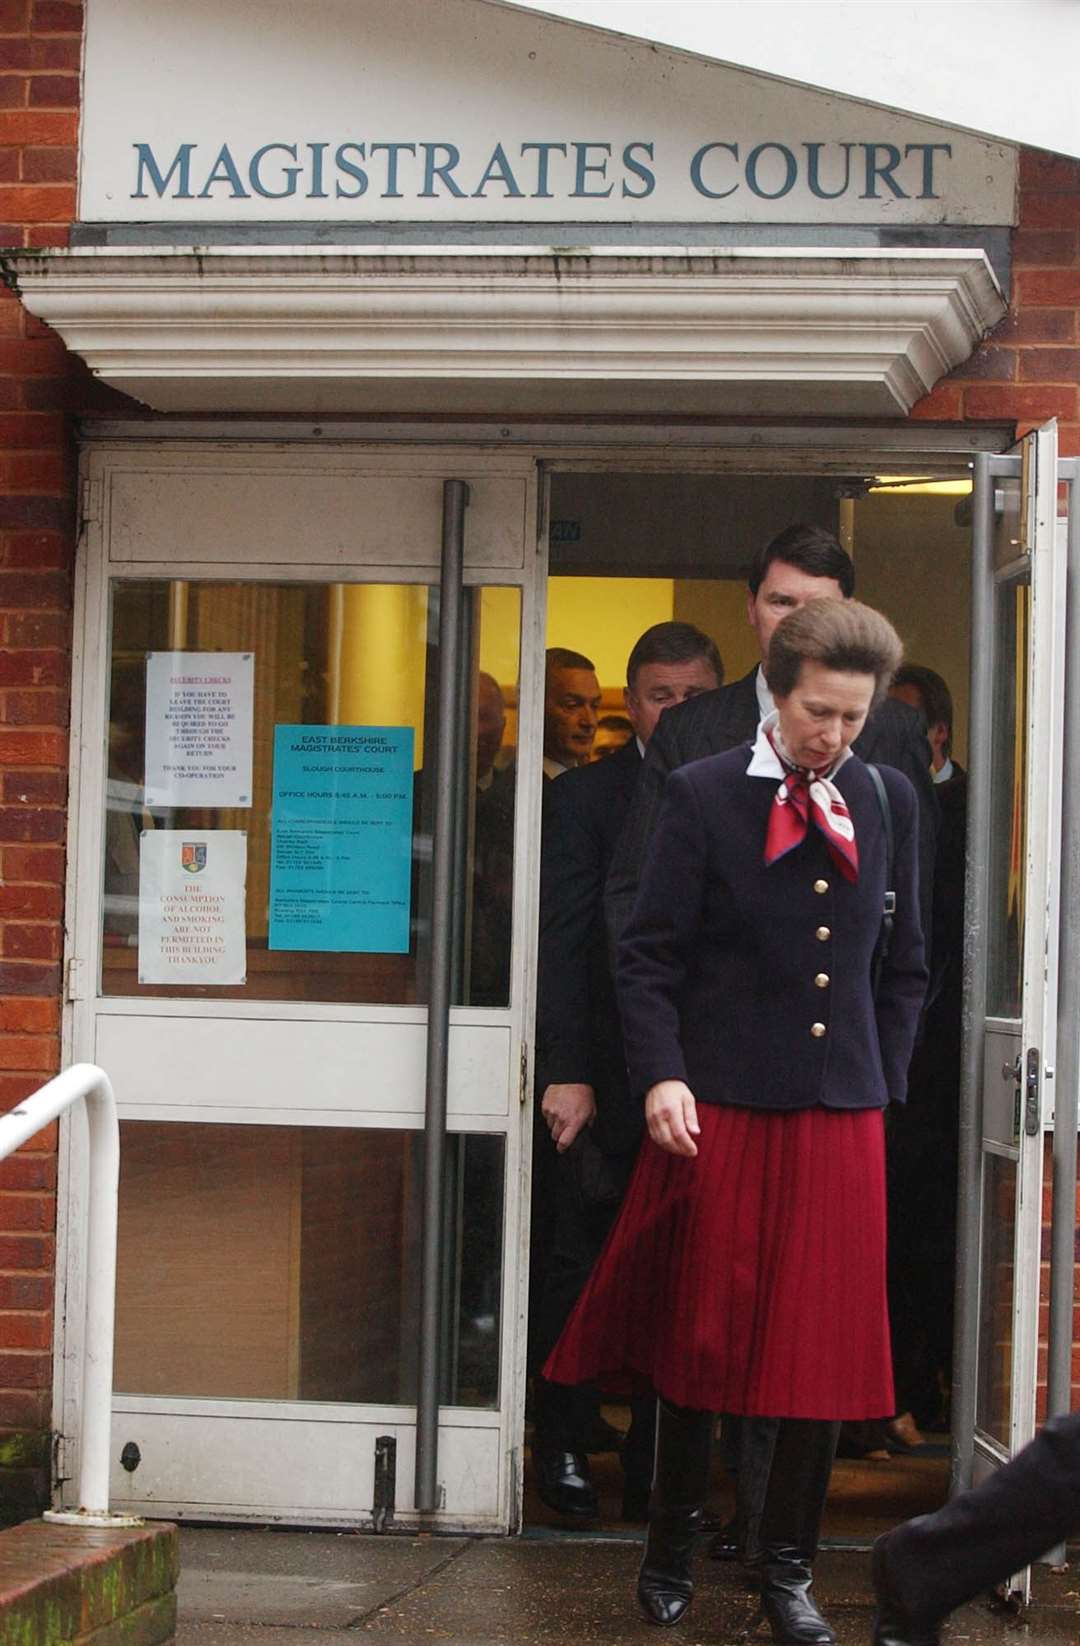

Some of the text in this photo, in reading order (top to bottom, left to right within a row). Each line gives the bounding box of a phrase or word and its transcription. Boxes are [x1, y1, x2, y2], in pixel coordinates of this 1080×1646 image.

[131, 143, 951, 199] MAGISTRATES COURT
[302, 736, 388, 744] EAST BERKSHIRE
[363, 745, 399, 753] COURT
[278, 791, 306, 799] OFFICE
[307, 791, 332, 799] HOURS
[159, 895, 225, 903] CONSUMPTION
[178, 905, 222, 913] ALCOHOL
[162, 915, 224, 923] AND SMOKING
[160, 946, 180, 954] THIS
